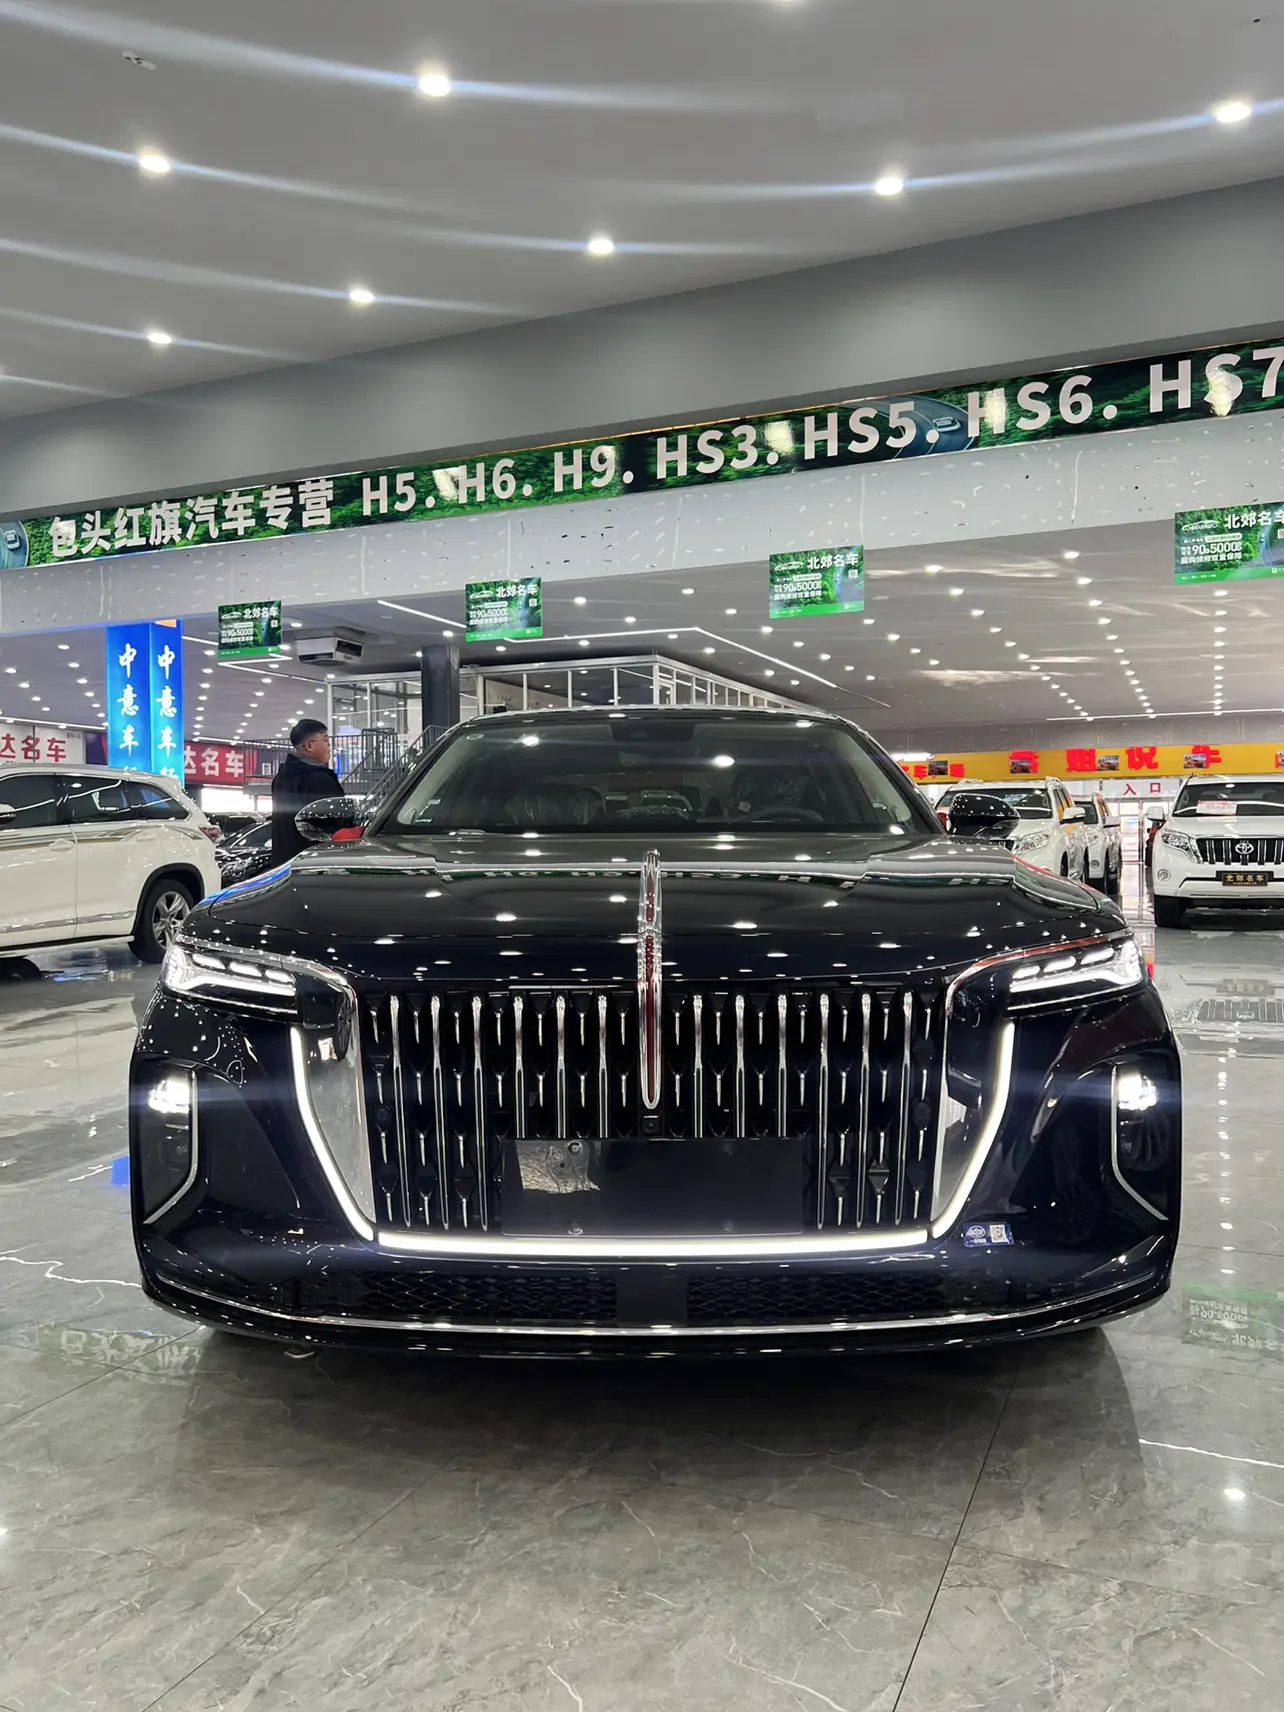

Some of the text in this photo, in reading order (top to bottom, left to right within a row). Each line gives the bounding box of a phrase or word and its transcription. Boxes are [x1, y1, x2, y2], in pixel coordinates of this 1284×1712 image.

[49, 478, 334, 557] 包头红旗汽车专营
[807, 552, 858, 570] 北郊名车
[1123, 782, 1161, 796] 入口
